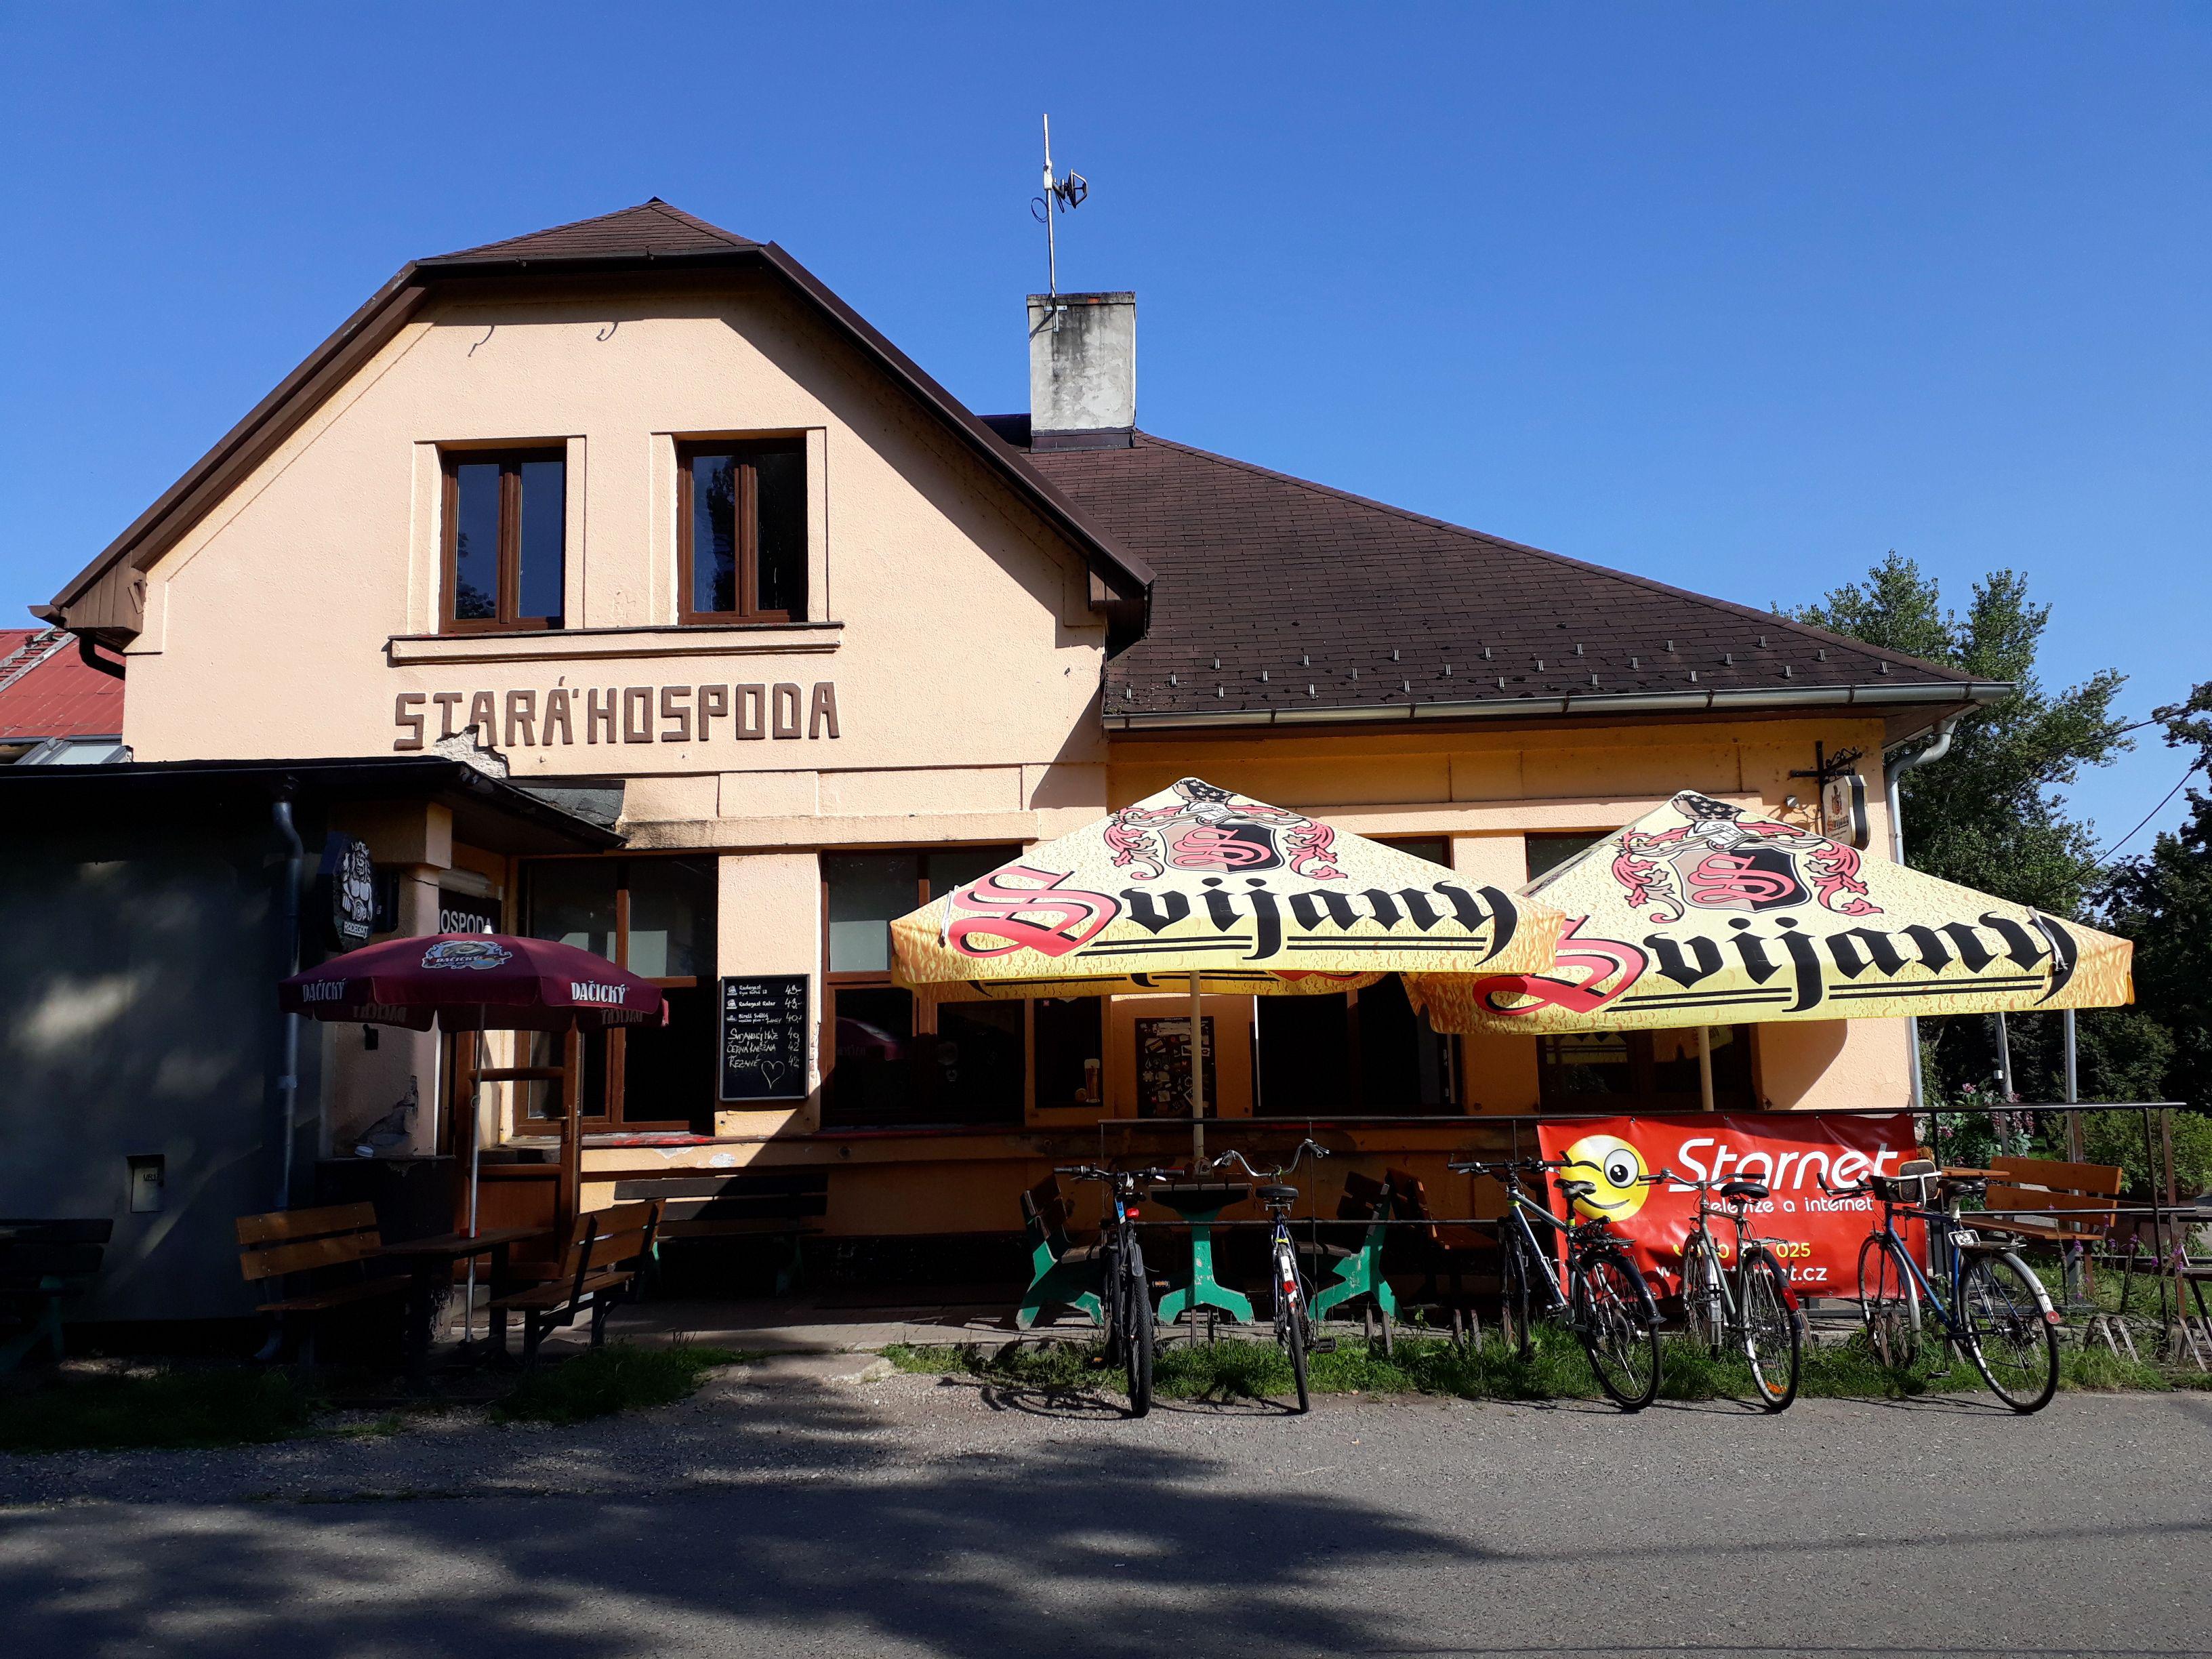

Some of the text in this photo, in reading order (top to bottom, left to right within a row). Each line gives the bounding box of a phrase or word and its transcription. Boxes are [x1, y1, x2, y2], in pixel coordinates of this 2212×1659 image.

[588, 681, 840, 744] HOSPODA
[439, 909, 491, 934] OSPOD
[949, 865, 1517, 966] Svijany
[1473, 911, 2078, 1012] Svijany
[302, 977, 347, 1003] DAČICKÝ
[571, 980, 626, 1004] DAČICKÝ
[739, 984, 762, 992] Radegast
[1668, 1138, 1899, 1193] Starnet
[1783, 1199, 1796, 1213] a
[1805, 1197, 1875, 1212] internet
[1775, 1242, 1811, 1258] 025
